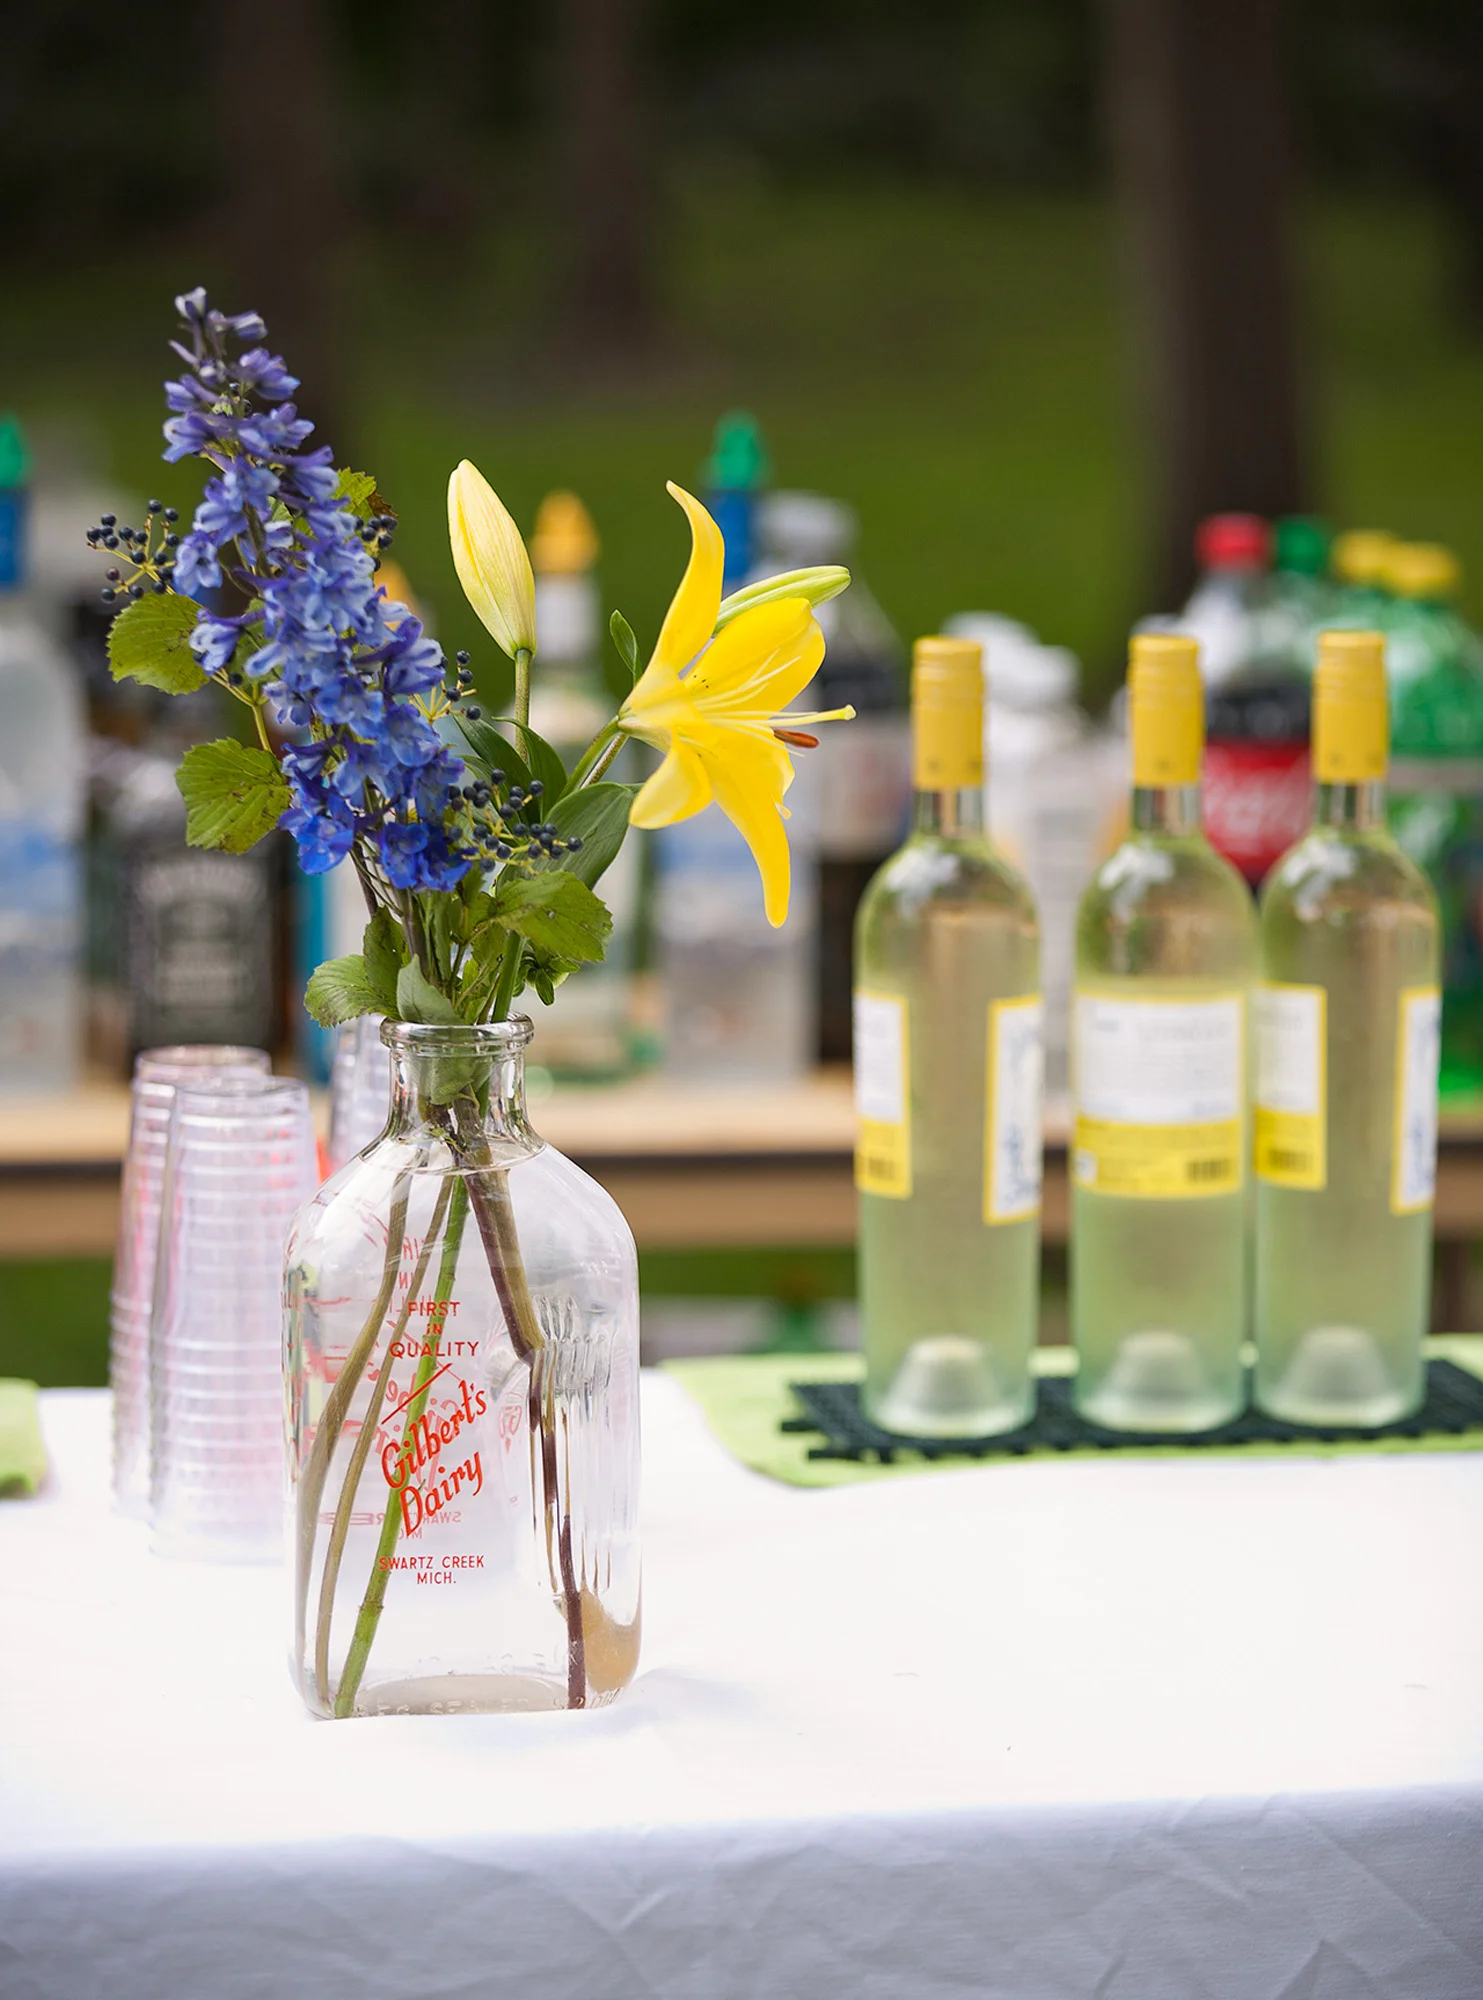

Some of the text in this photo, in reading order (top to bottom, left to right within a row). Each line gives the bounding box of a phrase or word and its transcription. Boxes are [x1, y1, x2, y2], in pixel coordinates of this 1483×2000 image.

[407, 1301, 461, 1317] FIRST
[389, 1340, 480, 1360] QUALITY
[381, 1379, 487, 1489] Gilbert's
[400, 1451, 483, 1537] Dairy
[379, 1555, 485, 1571] SWARTZ CREEK
[416, 1571, 457, 1585] MICH.
